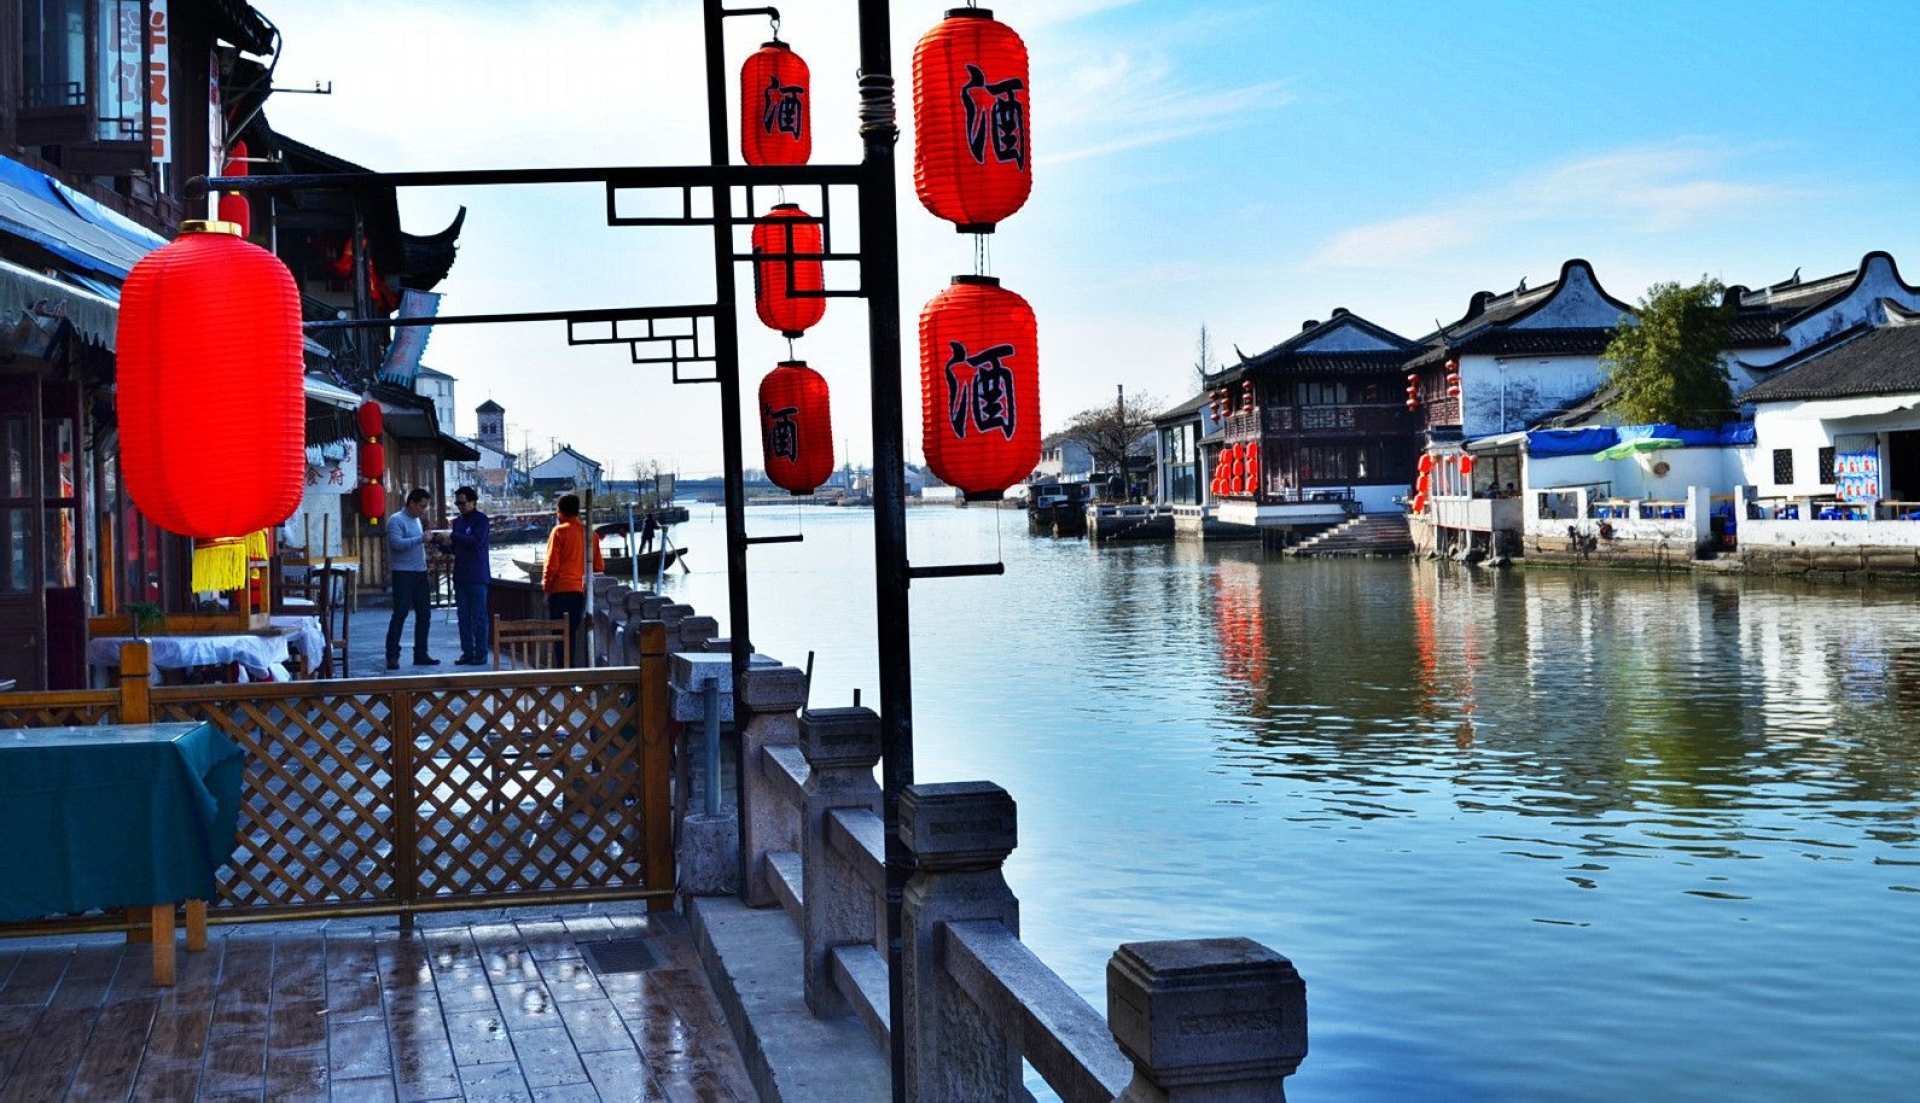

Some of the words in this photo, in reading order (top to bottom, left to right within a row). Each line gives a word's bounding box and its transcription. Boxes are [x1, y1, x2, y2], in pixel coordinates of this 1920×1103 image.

[763, 73, 805, 142] 酒
[959, 63, 1024, 173] 酒
[944, 340, 1016, 440] 酒
[761, 402, 800, 465] 酒
